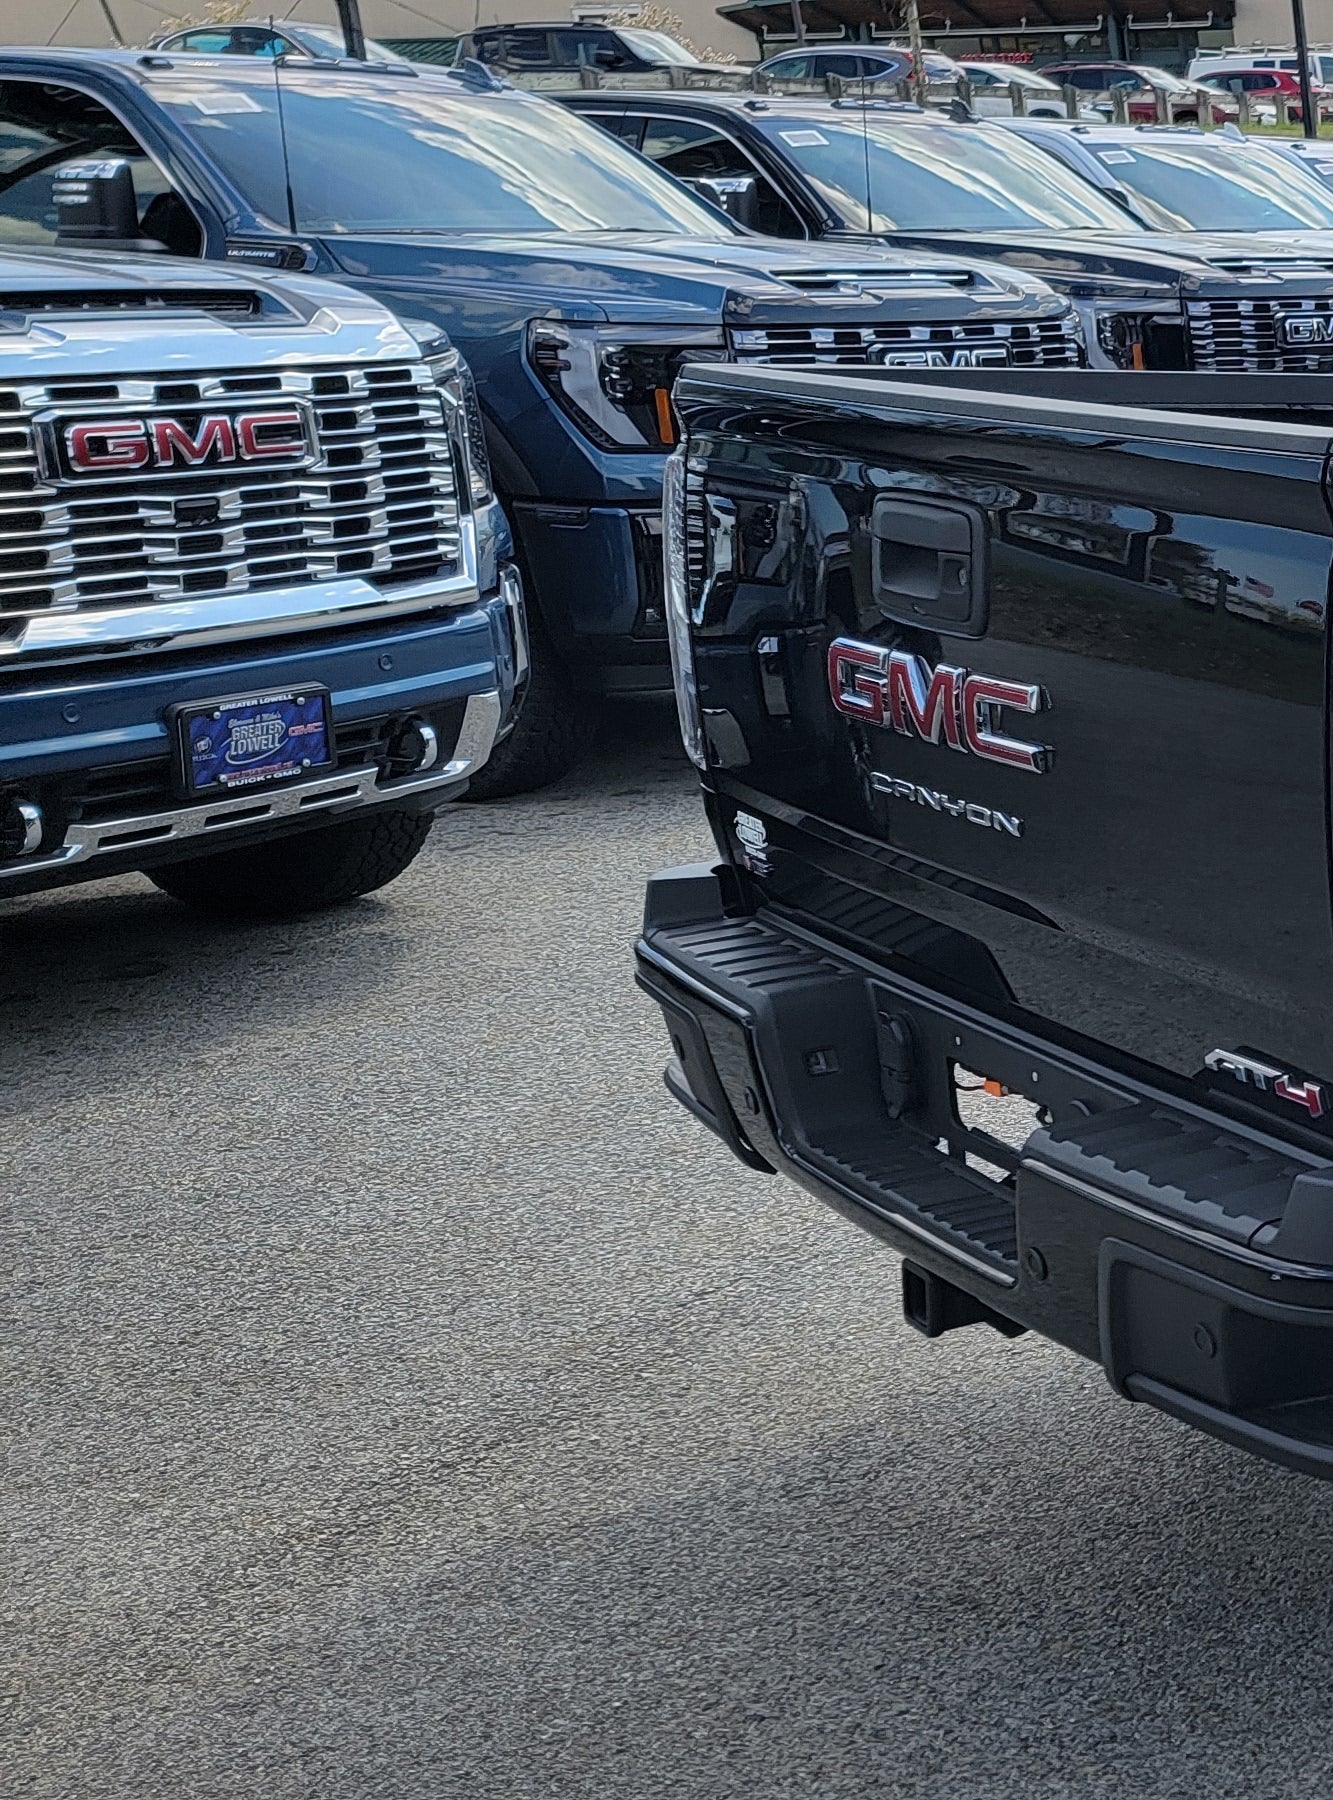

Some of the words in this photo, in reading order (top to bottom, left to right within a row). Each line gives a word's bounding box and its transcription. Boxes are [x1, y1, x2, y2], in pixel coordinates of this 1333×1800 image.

[64, 410, 307, 473] GMC
[219, 699, 258, 711] GREATER
[259, 693, 295, 705] LOWELL
[827, 636, 1054, 775] GMC
[230, 733, 281, 755] LOWELL
[231, 721, 283, 741] GREATER
[227, 776, 266, 788] BUICK
[273, 768, 302, 779] GMC
[869, 771, 1026, 839] CANYON
[1204, 1048, 1326, 1119] AT4
